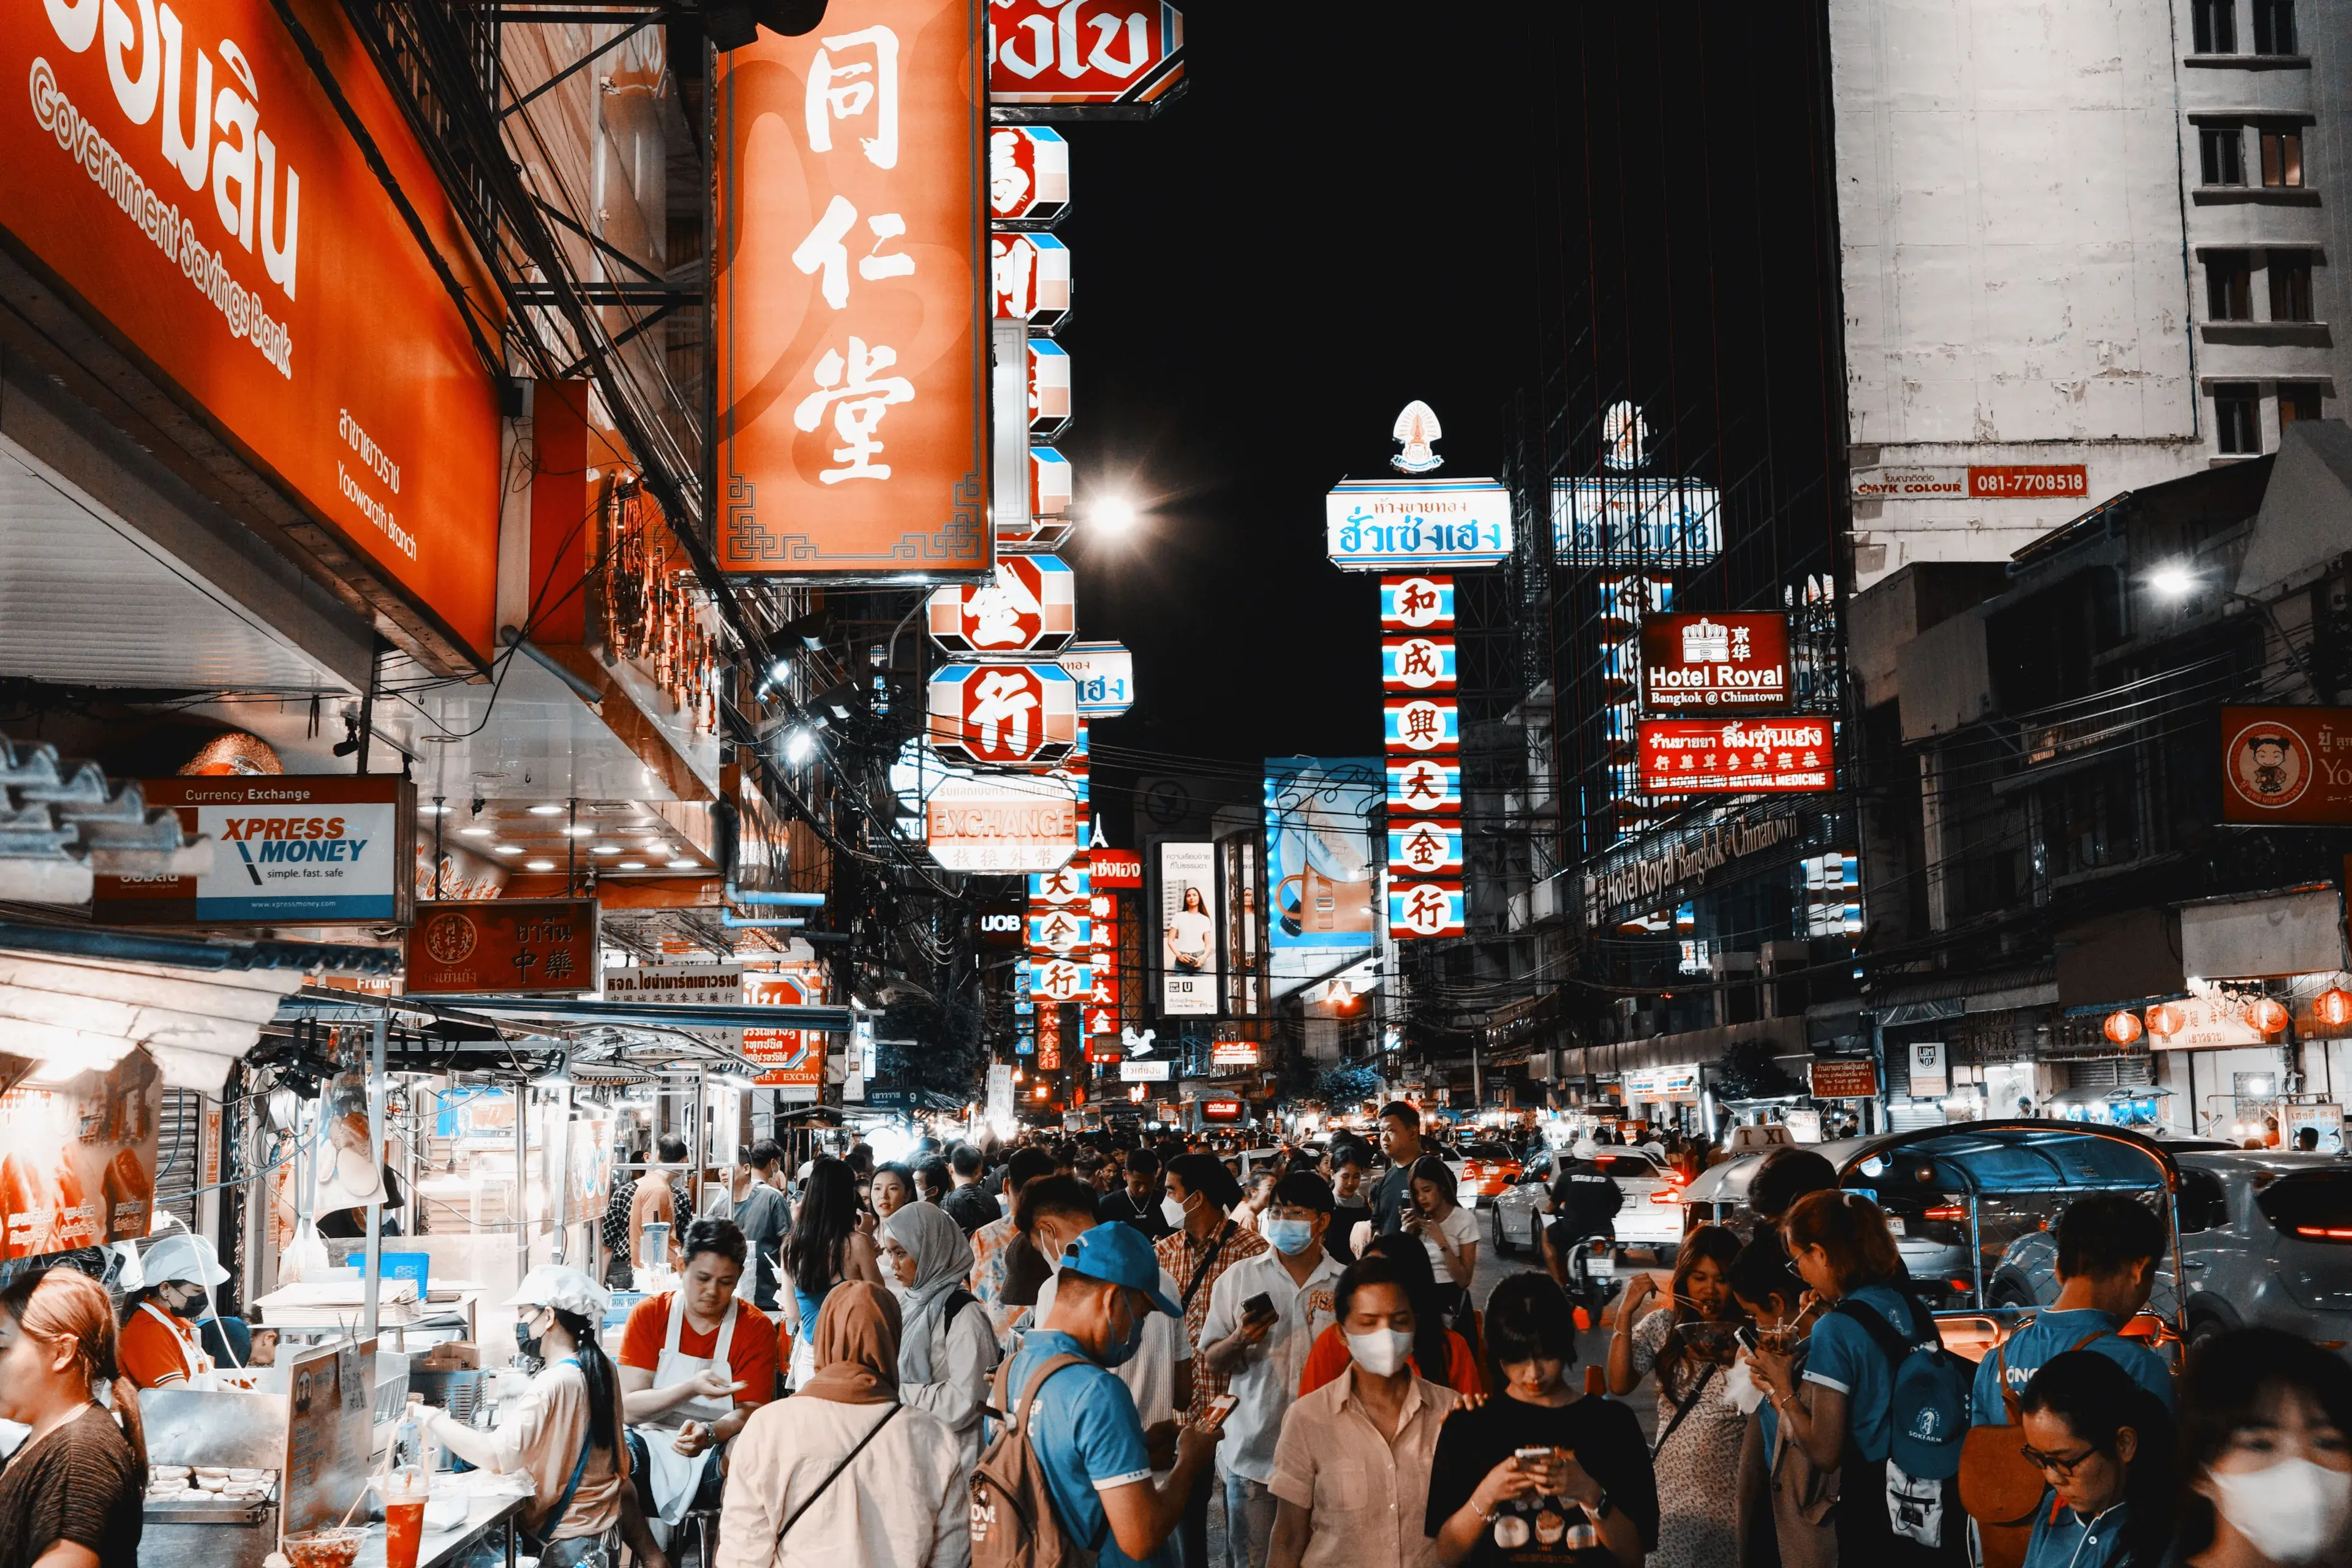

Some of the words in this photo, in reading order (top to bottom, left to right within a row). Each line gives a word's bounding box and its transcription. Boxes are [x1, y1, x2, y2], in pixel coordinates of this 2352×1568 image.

[43, 0, 300, 303] อมสิน
[29, 56, 179, 263] Government
[180, 218, 251, 338] Savings
[251, 292, 292, 380] Bank
[792, 24, 916, 484] 同仁堂
[339, 408, 400, 494] สาขาเยาวราช
[1858, 483, 1898, 492] CMYK
[1904, 483, 1961, 493] COLOUR
[1978, 474, 2083, 491] 081-7708518
[337, 459, 386, 533] Yaowarath
[388, 512, 417, 562] Branch
[1374, 497, 1466, 513] ห้างขายทอง
[1340, 506, 1501, 552] ฮั่วเซ่งเฮง
[1730, 626, 1751, 660] 京华
[1650, 666, 1709, 687] Hotel
[1717, 665, 1783, 687] Royal
[1651, 692, 1702, 705] Bangkok
[1705, 692, 1719, 704] @
[1721, 690, 1784, 703] Chinatown
[1401, 584, 1446, 929] 和成興大金行
[1649, 776, 1667, 788] LIM
[1670, 776, 1697, 788] SOON
[1730, 774, 1774, 787] NATURAL
[1776, 773, 1825, 786] MEDICINE
[186, 790, 244, 801] Currency
[247, 788, 311, 800] Exchange
[221, 818, 345, 840] XPRESS
[930, 809, 1074, 837] EXCHANGE
[258, 840, 368, 862] MONEY
[1608, 860, 1638, 908] Hotel
[1641, 844, 1675, 898] Royal
[1678, 826, 1726, 885] Bangkok
[1732, 811, 1798, 858] Chinatown
[267, 869, 301, 879] simple.
[303, 867, 323, 877] fast.
[325, 867, 344, 877] safe
[518, 918, 573, 943] ยาจีน
[981, 915, 1021, 932] UOB
[512, 948, 576, 983] 中藥
[357, 978, 391, 989] Fruit
[1918, 1047, 1935, 1056] LUMI
[1920, 1058, 1934, 1067] NOX
[751, 1072, 778, 1081] ONEY
[910, 1093, 916, 1102] 9
[1908, 1430, 1942, 1442] SOKFARM
